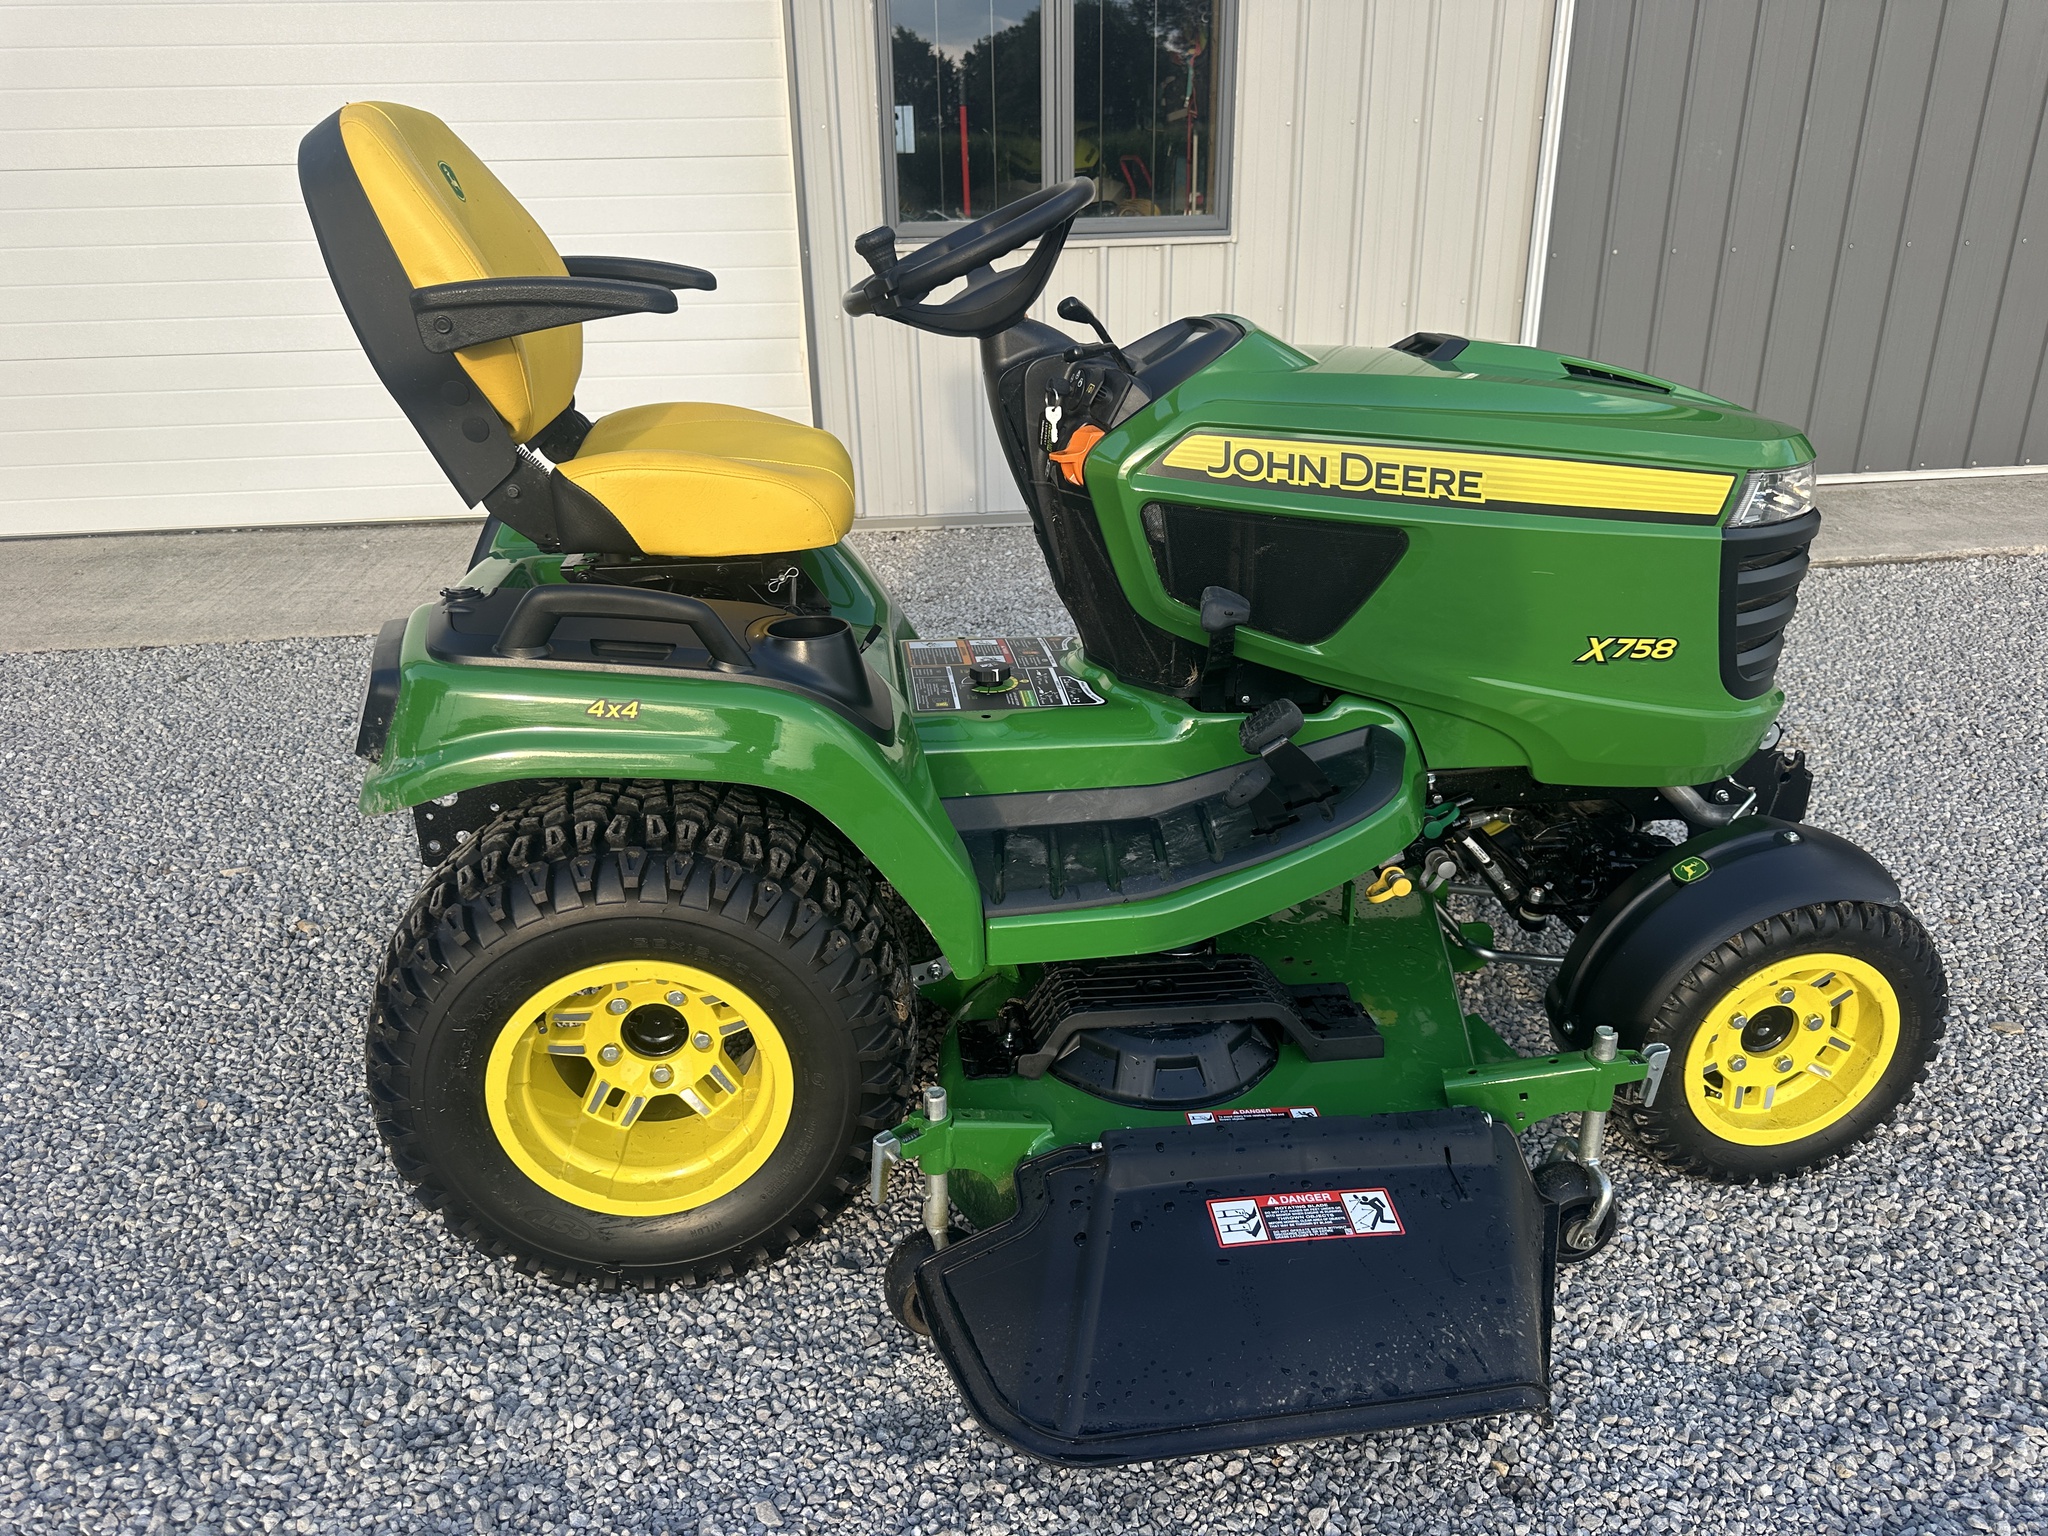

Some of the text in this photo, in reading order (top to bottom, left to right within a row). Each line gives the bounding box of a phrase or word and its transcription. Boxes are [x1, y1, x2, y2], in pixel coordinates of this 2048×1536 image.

[1208, 440, 1484, 501] JOHN DEERE
[1572, 636, 1680, 664] X758
[586, 699, 640, 719] 4x4
[1279, 1193, 1332, 1203] DANGER
